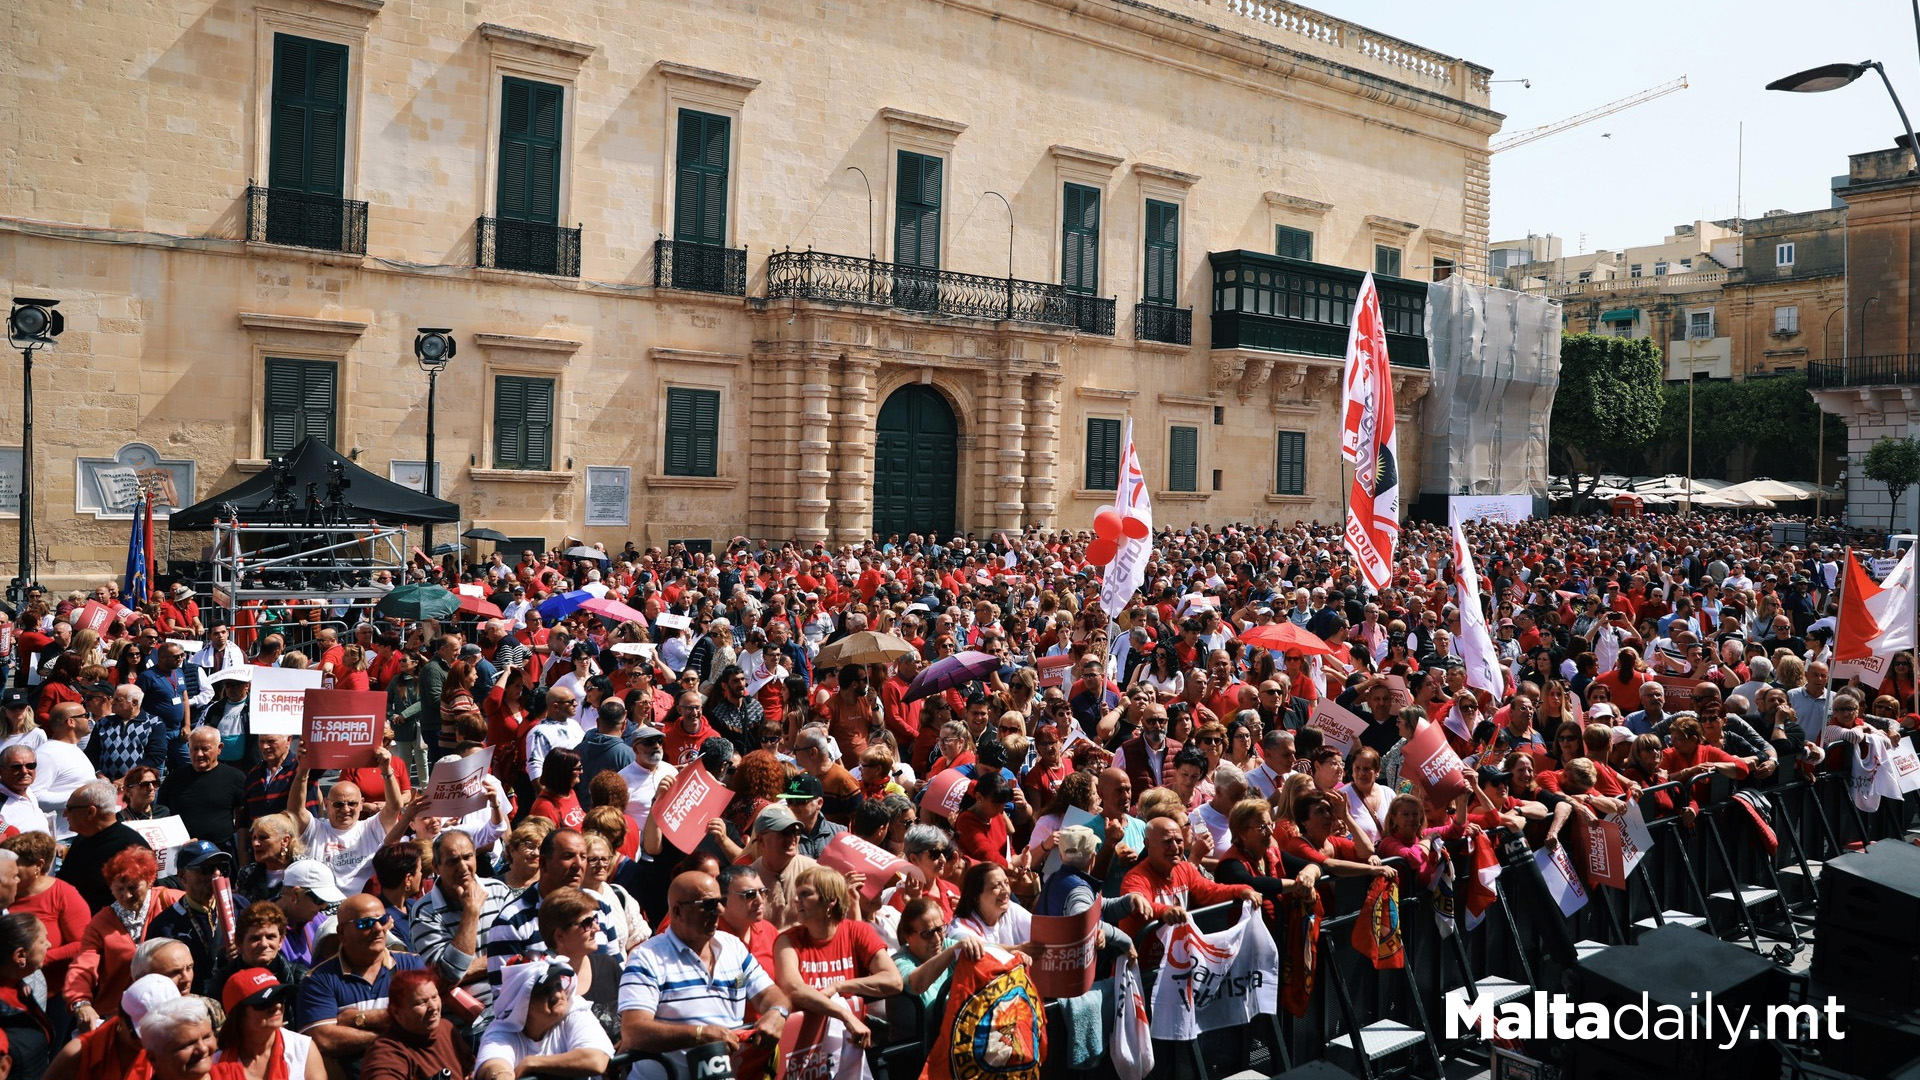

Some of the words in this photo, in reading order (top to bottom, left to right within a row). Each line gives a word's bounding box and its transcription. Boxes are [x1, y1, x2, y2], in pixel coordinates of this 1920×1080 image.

[1346, 514, 1379, 570] ABOUR
[801, 961, 829, 973] PROUD
[830, 960, 842, 972] TO
[842, 956, 854, 970] BE
